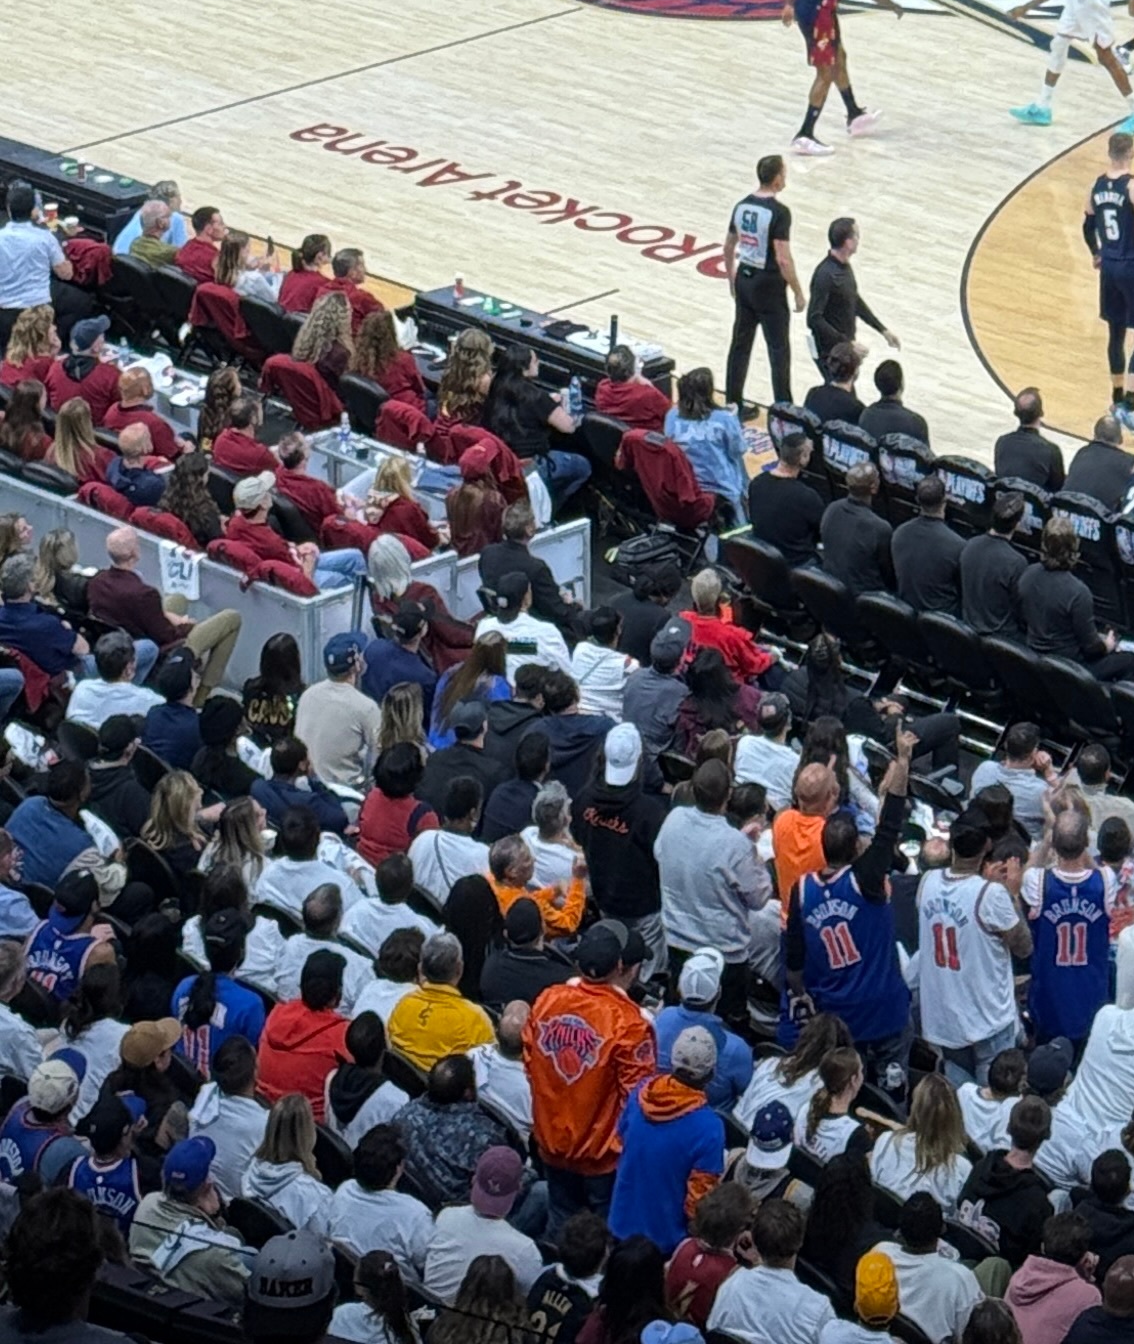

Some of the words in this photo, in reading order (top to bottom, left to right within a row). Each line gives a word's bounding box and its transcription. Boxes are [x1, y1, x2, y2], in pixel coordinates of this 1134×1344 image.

[289, 122, 497, 187] Arena
[465, 179, 724, 265] Rocket
[741, 209, 759, 233] 58
[1103, 209, 1119, 241] 5
[820, 921, 862, 970] 11
[932, 921, 961, 972] 11
[1056, 921, 1088, 967] 11
